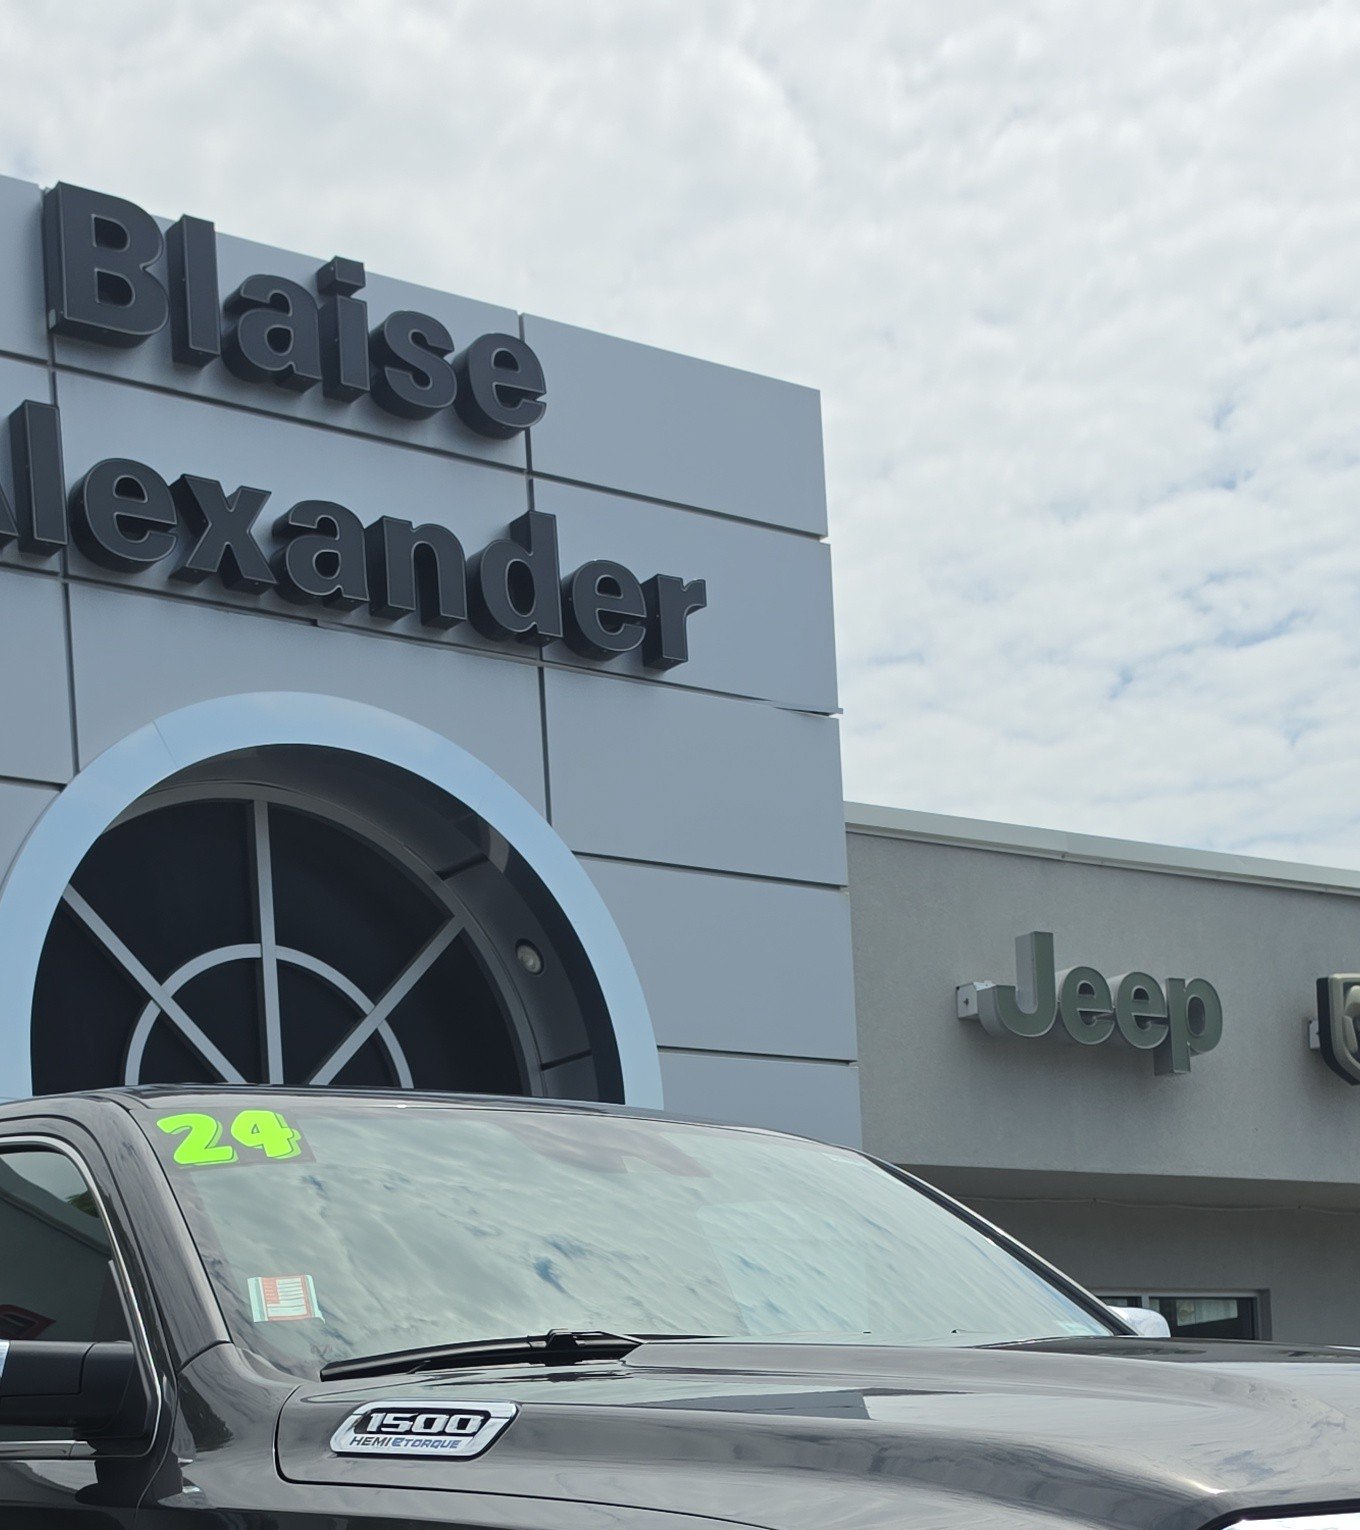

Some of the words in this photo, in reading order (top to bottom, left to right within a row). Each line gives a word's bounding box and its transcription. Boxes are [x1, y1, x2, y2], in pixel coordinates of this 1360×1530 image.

[42, 180, 547, 441] Blaise
[978, 931, 1223, 1077] Jeep
[156, 1109, 302, 1166] 24
[349, 1436, 391, 1447] HEMI
[366, 1412, 484, 1434] 1500
